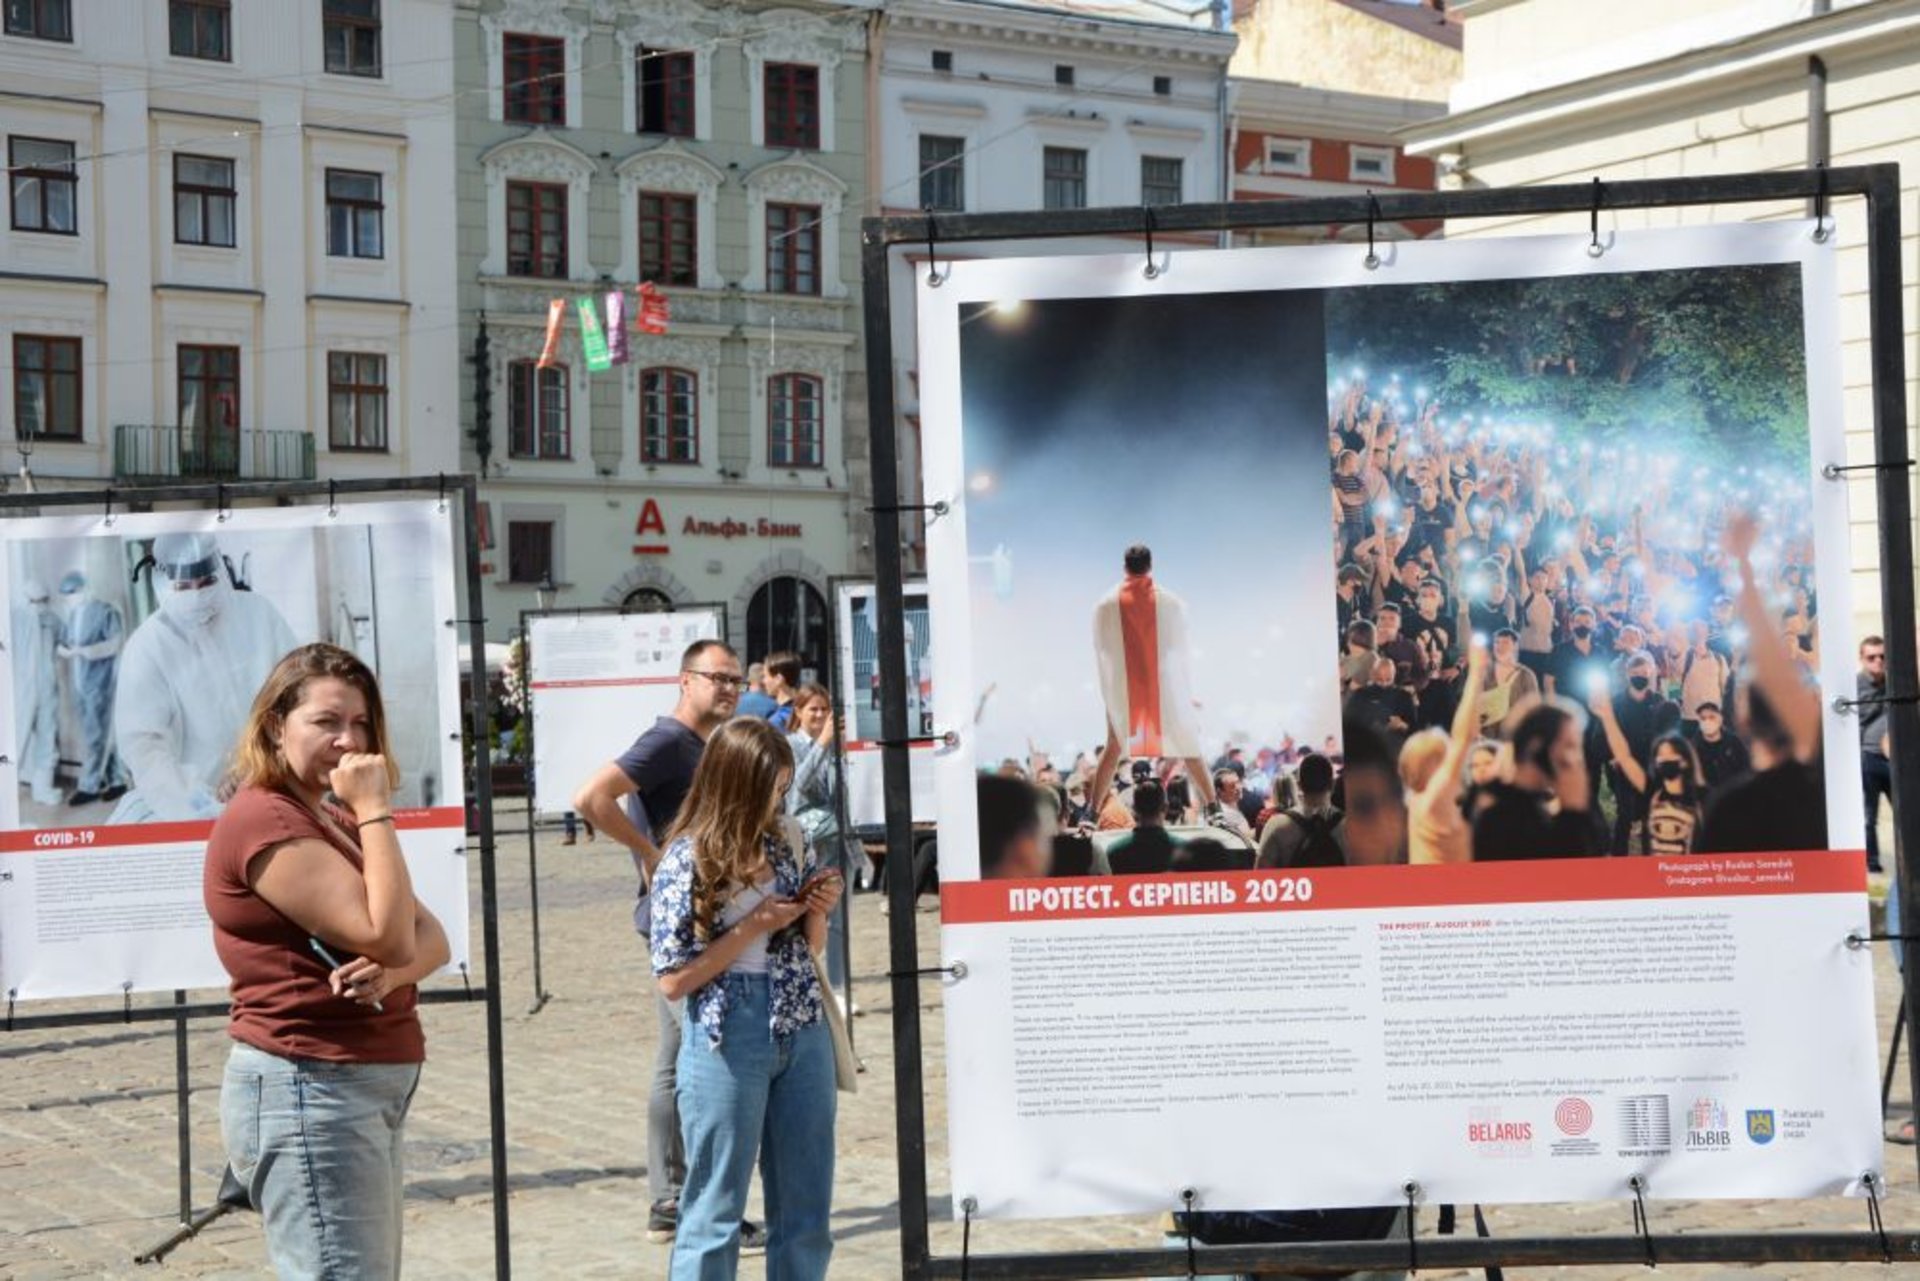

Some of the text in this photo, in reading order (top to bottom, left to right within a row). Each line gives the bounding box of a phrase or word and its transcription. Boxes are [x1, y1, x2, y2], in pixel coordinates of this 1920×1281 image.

[34, 831, 95, 846] COVID-19
[1658, 864, 1710, 873] Photograph
[1712, 862, 1723, 871] by
[1009, 877, 1313, 912] ПРОТЕСТ. СЕРПЕНЬ 2020
[1468, 1123, 1533, 1142] BELARUS
